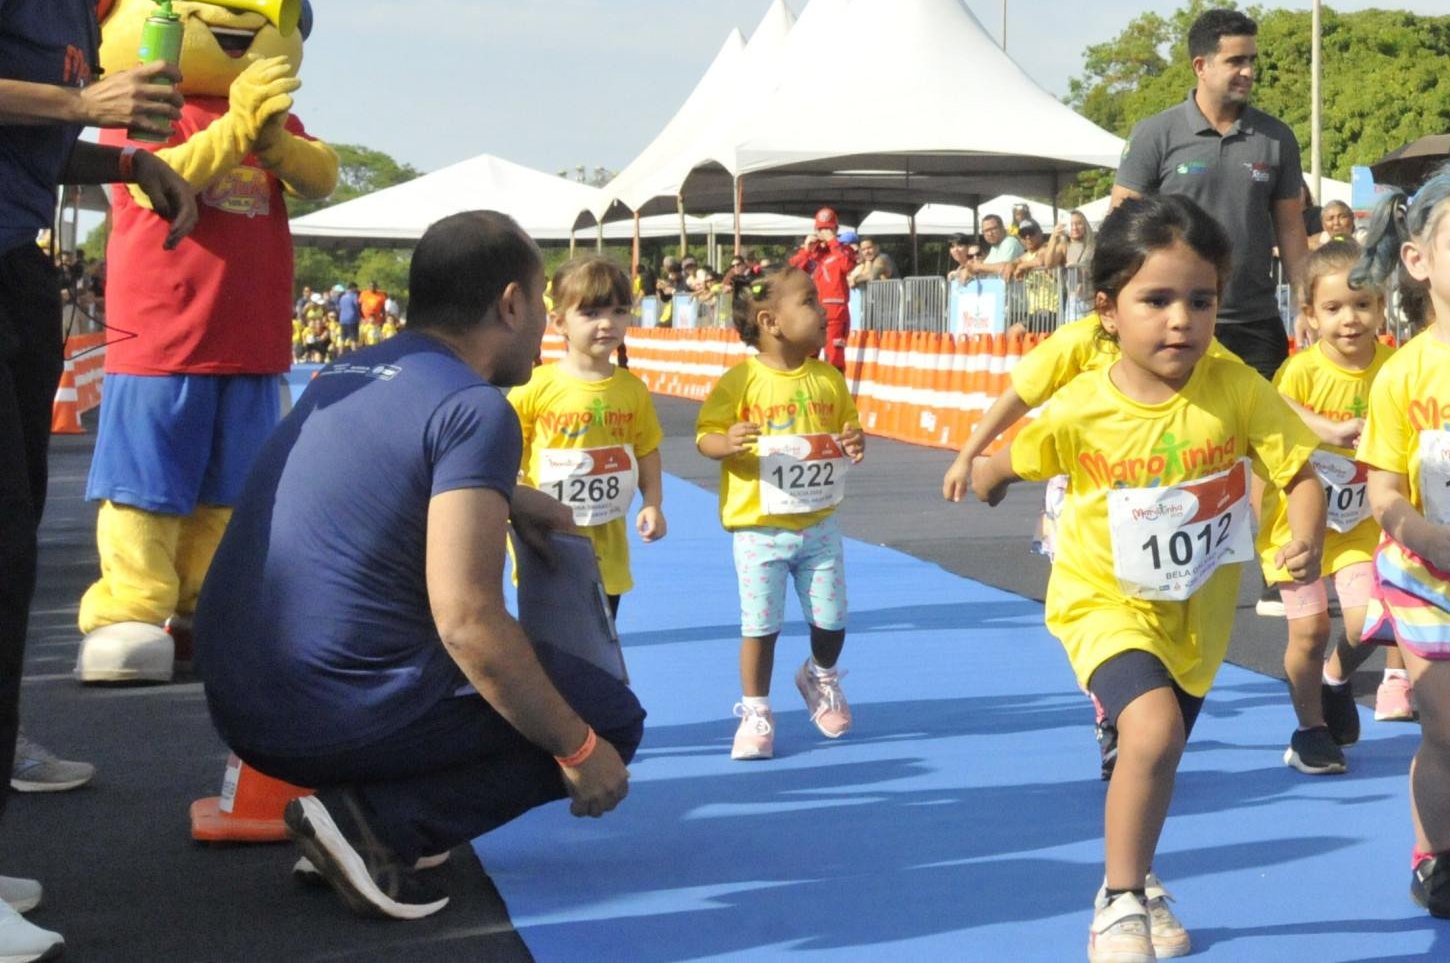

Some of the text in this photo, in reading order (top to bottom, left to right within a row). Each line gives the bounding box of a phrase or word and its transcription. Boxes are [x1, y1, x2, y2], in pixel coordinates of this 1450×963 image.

[772, 462, 834, 489] 1222
[551, 476, 620, 503] 1268
[1325, 485, 1366, 511] 101
[1142, 512, 1232, 570] 1012
[1165, 569, 1191, 580] BELA
